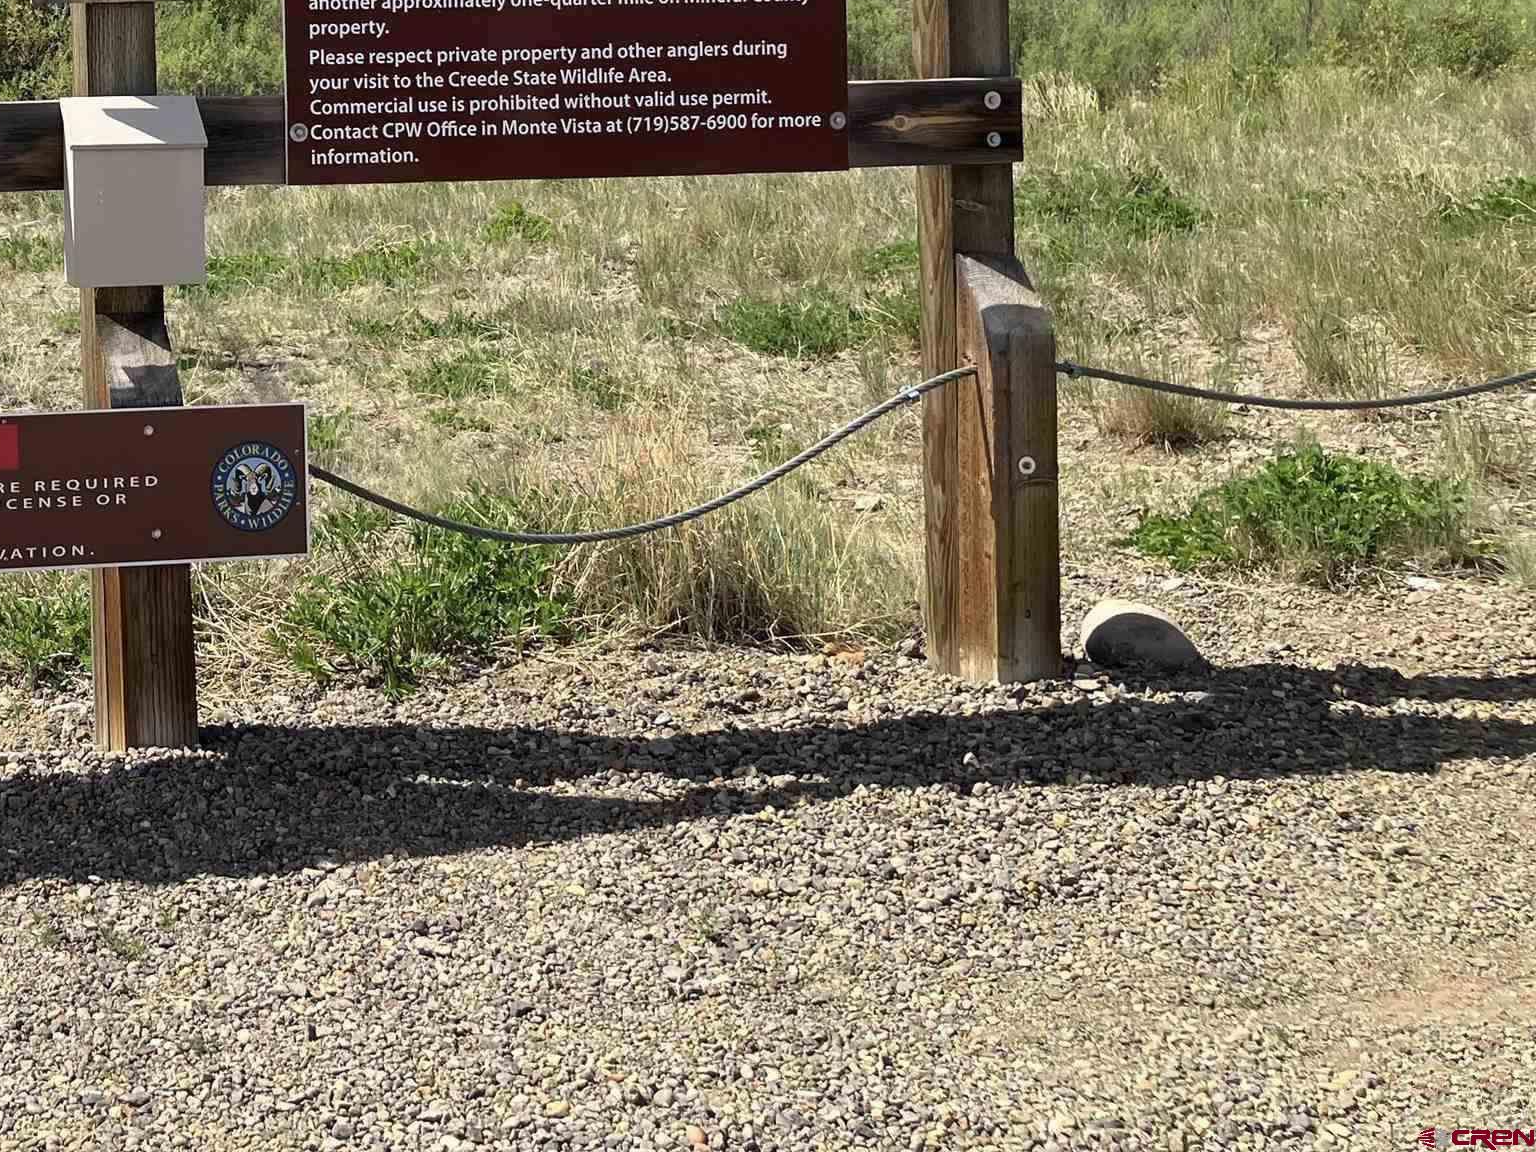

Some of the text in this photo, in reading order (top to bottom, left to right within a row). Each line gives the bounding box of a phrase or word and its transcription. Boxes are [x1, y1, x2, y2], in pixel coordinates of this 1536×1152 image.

[309, 20, 390, 40] property.
[311, 147, 419, 165] information.
[218, 444, 289, 473] COLORADO
[35, 475, 158, 492] REQUIRED
[96, 493, 126, 506] OR
